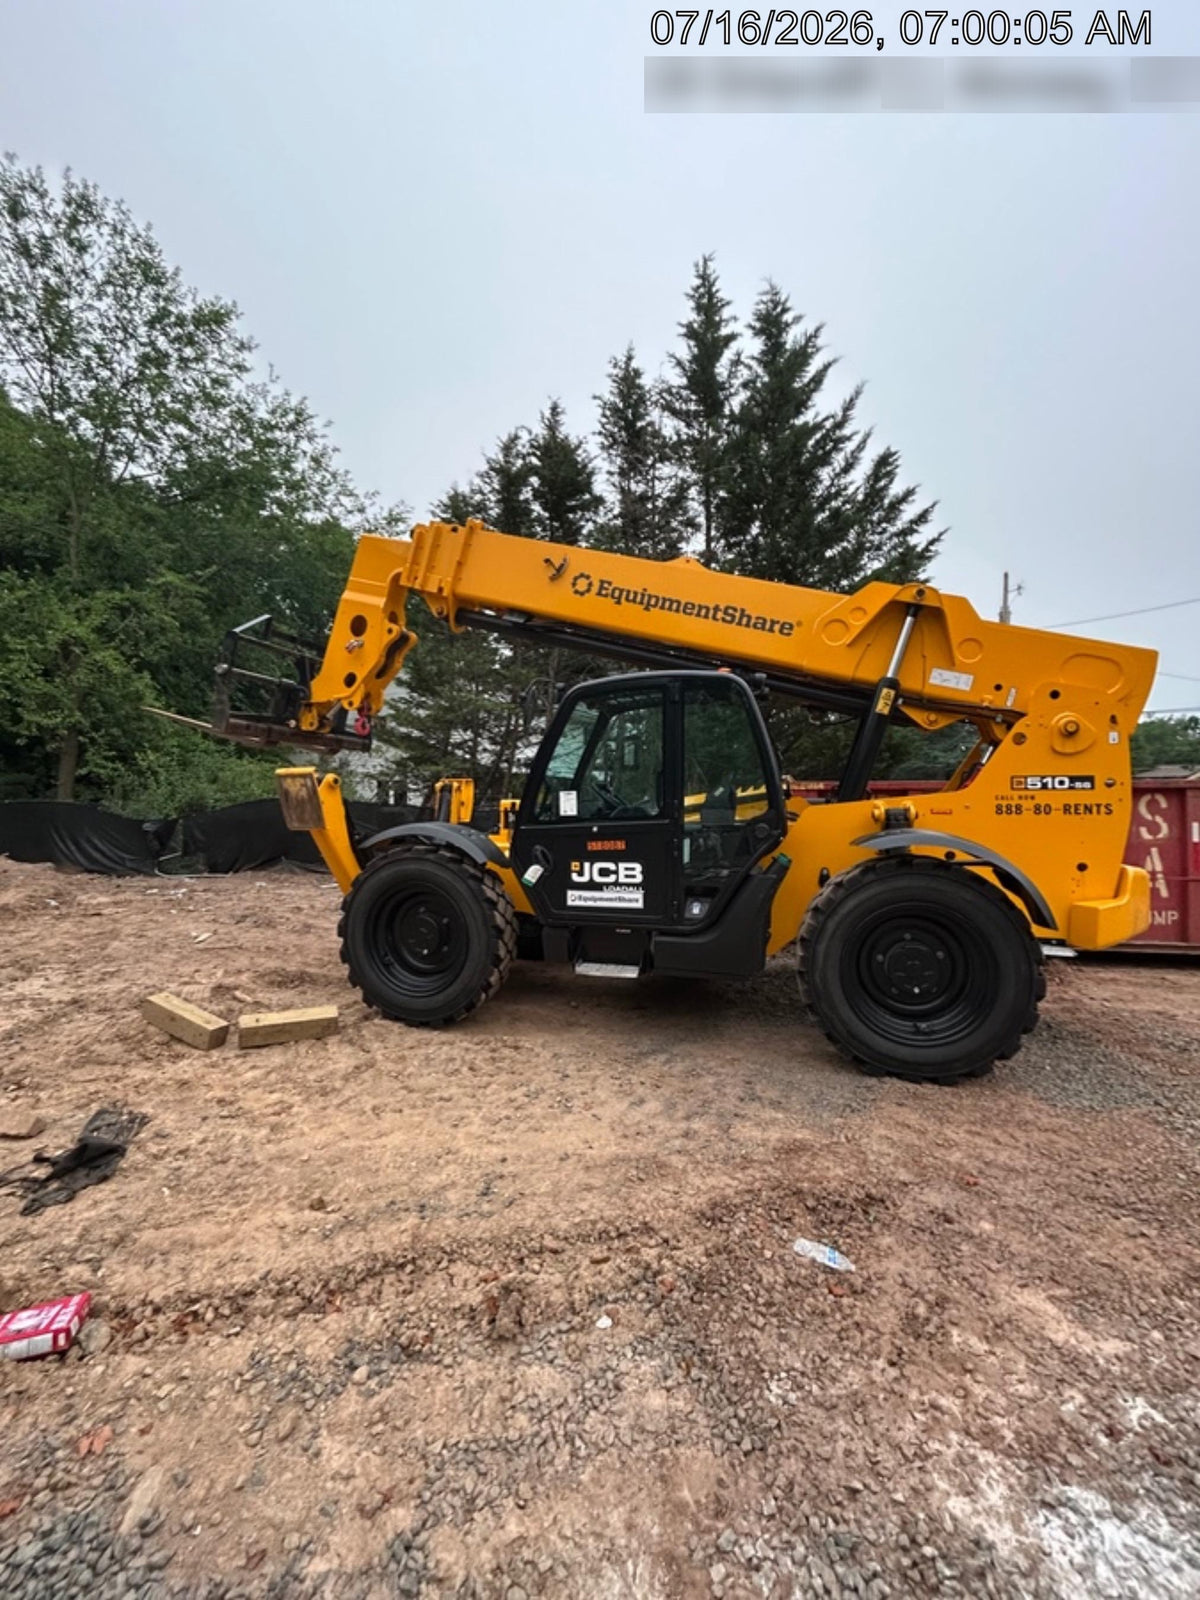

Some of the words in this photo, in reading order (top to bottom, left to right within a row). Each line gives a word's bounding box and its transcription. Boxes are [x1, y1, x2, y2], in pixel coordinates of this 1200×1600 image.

[595, 578, 795, 637] EquipmentShare
[995, 803, 1113, 816] 888-80-RENTS
[571, 861, 643, 883] JCB
